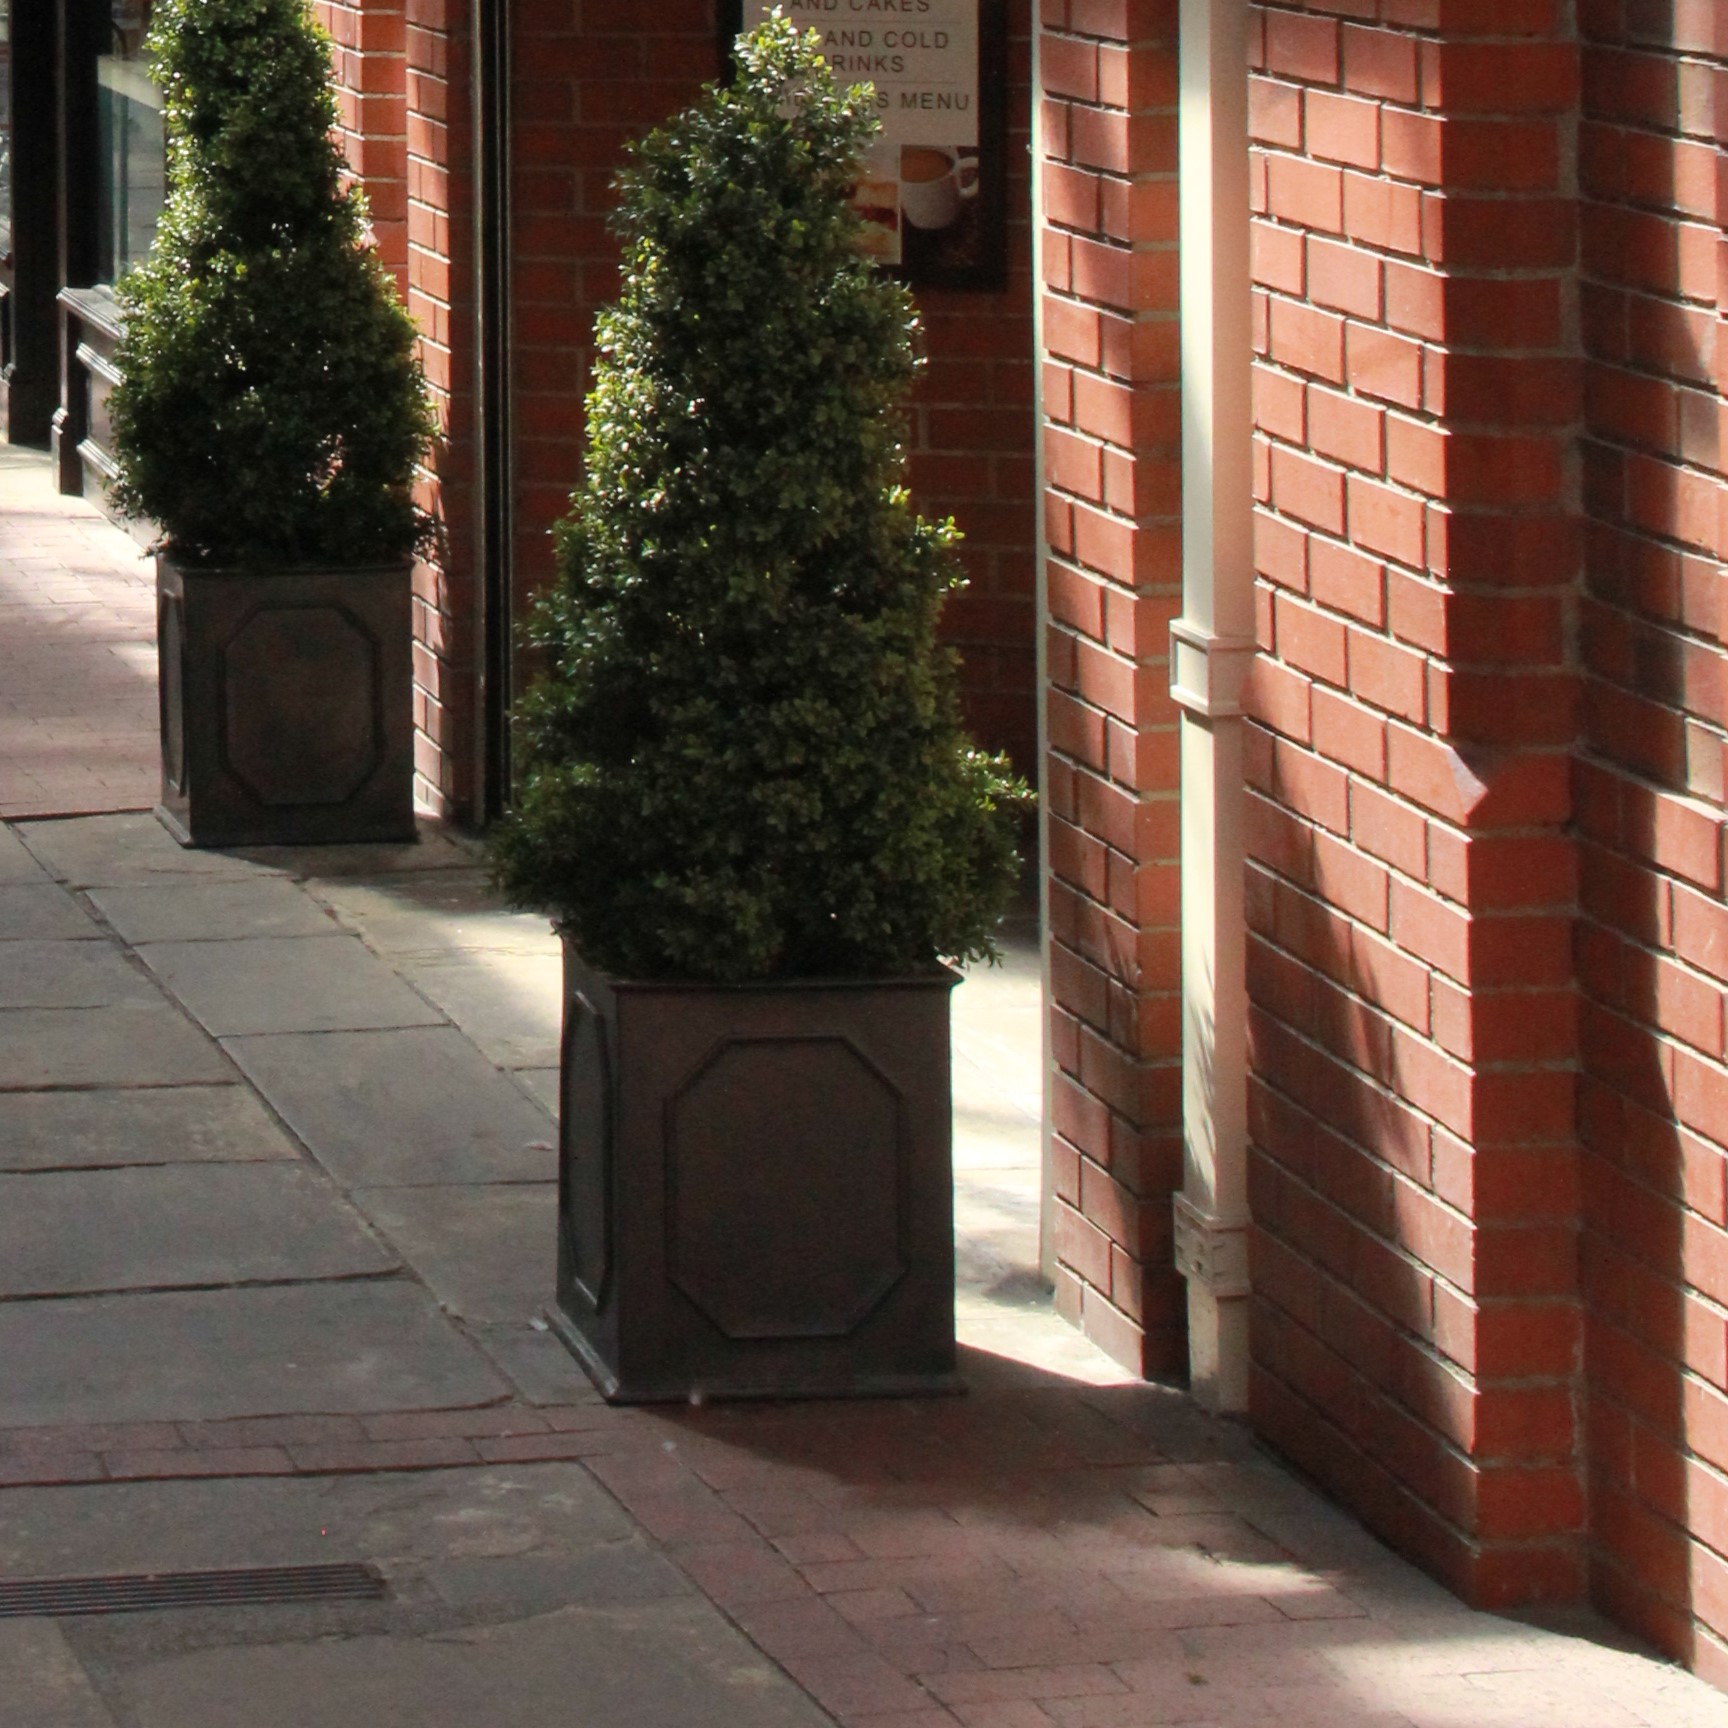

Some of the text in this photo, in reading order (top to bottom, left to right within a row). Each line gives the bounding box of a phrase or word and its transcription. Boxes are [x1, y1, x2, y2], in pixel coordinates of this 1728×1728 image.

[825, 30, 873, 48] AND
[883, 30, 950, 49] COLD
[824, 55, 905, 73] RINKS
[900, 92, 970, 111] MENU
